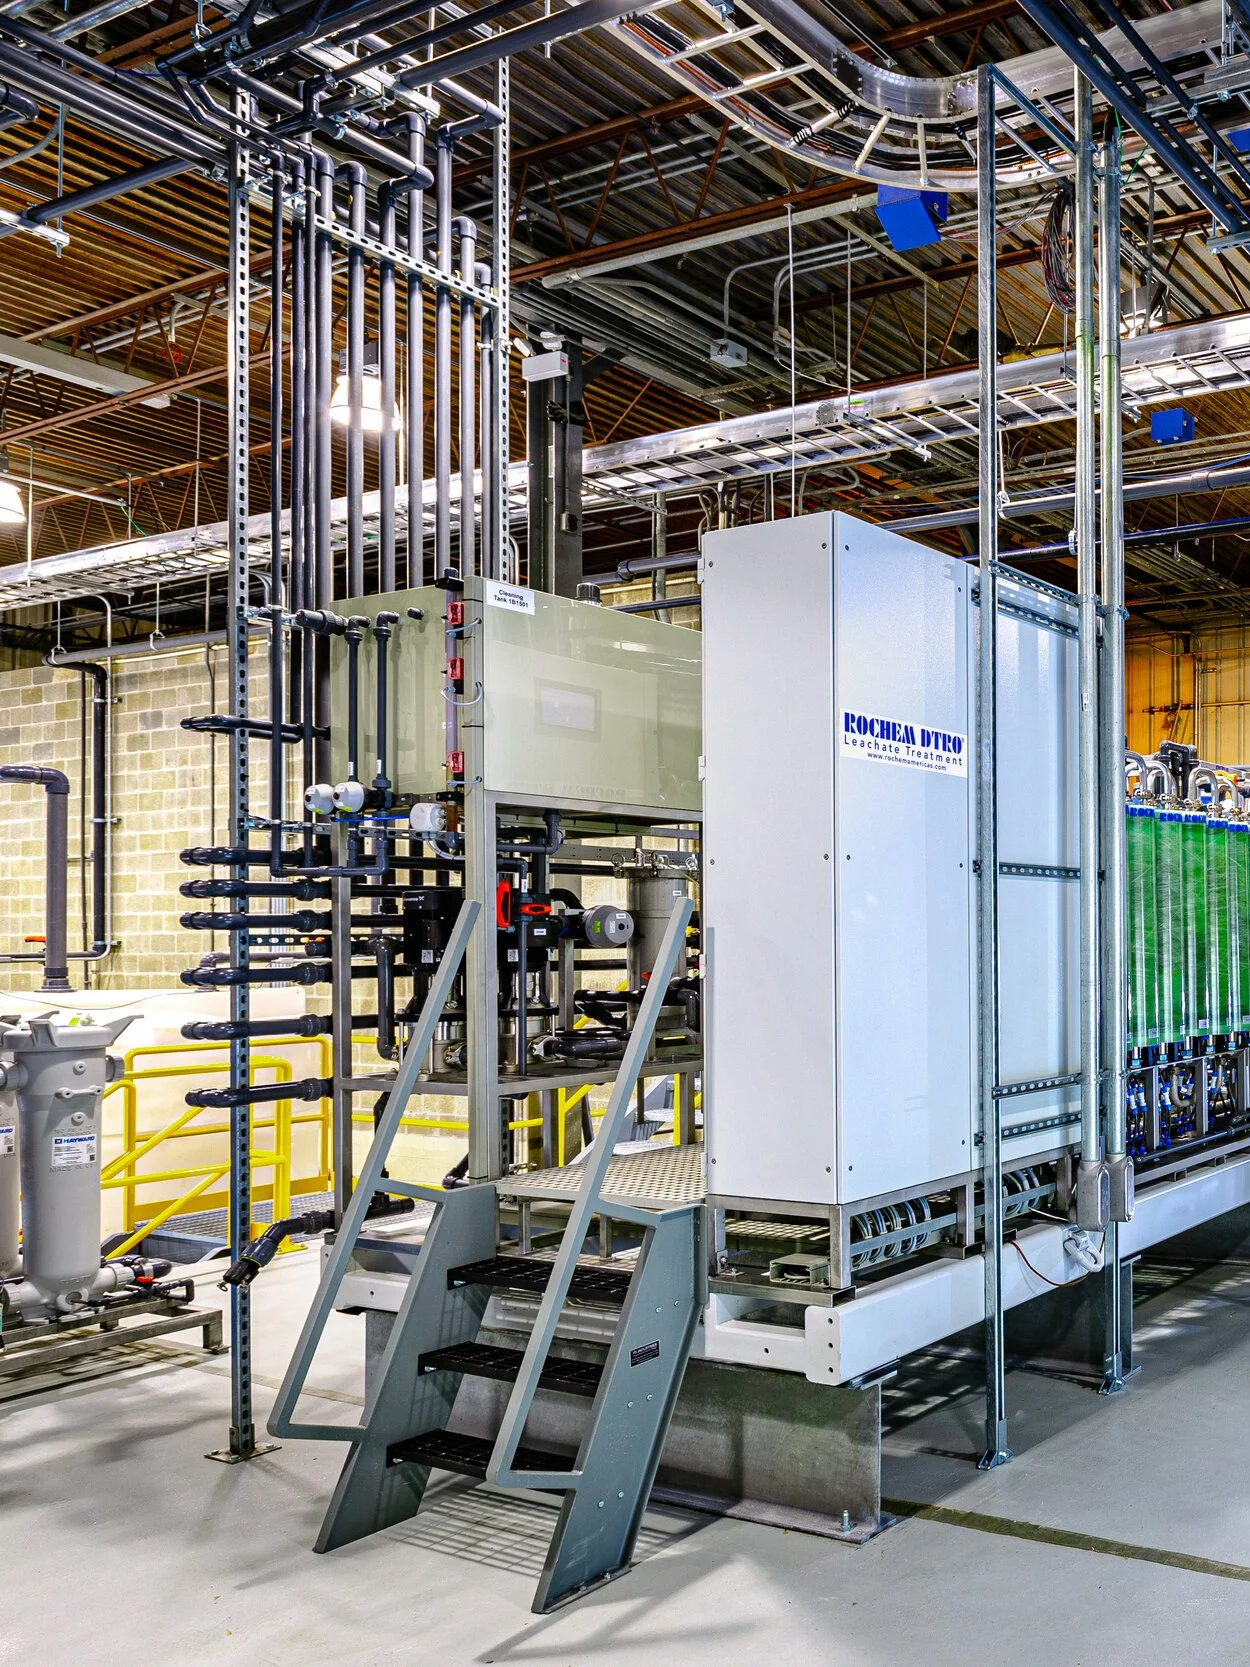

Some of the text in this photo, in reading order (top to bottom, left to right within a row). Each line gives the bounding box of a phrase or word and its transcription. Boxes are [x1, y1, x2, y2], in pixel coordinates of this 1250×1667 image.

[493, 594, 507, 602] Tank
[498, 589, 524, 601] Cleaning
[844, 711, 916, 746] ROCHEM
[844, 734, 963, 766] Leachate Treatment
[867, 752, 947, 771] www.rochemamericas.com
[63, 1135, 95, 1144] HAYWARD
